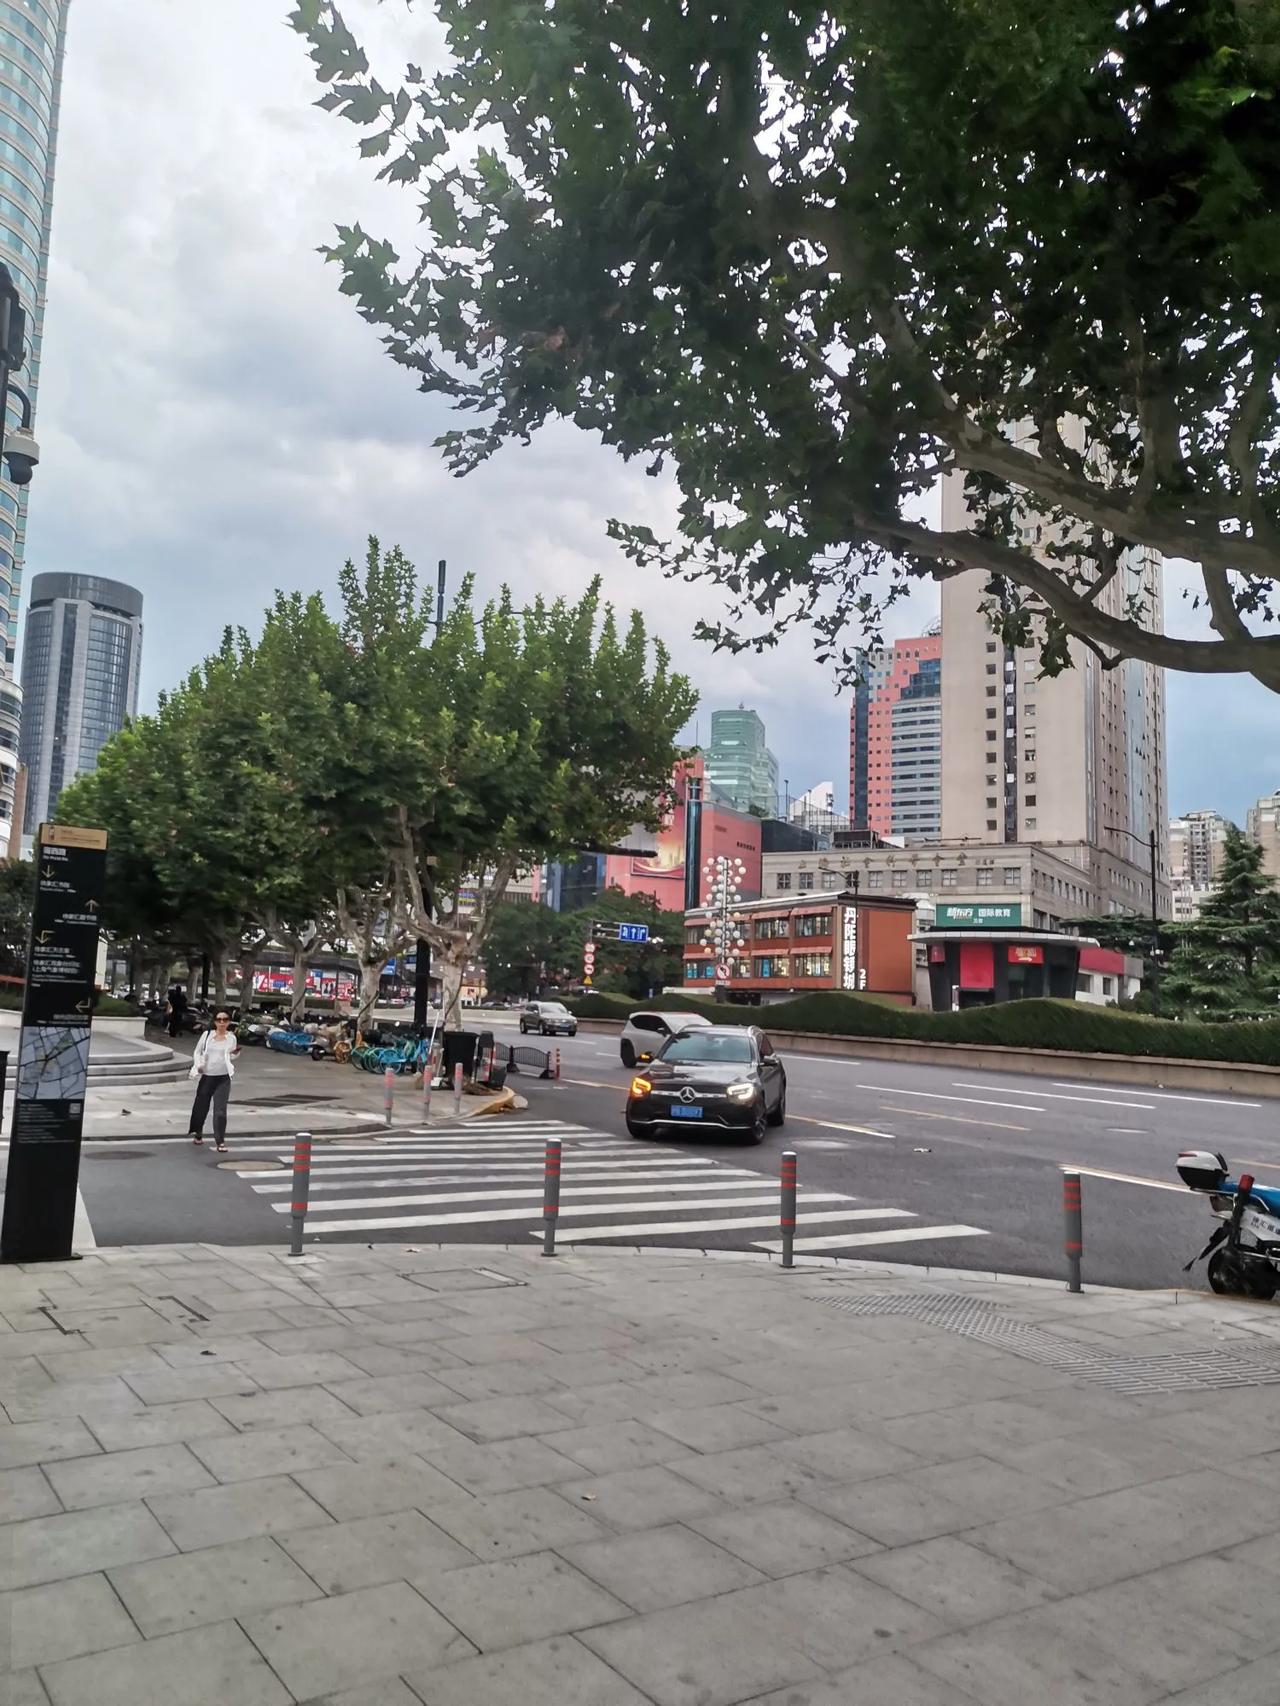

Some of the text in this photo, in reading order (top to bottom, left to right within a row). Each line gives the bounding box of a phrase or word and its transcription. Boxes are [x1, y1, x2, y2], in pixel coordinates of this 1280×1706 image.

[946, 907, 1011, 919] 新东方 国际教育
